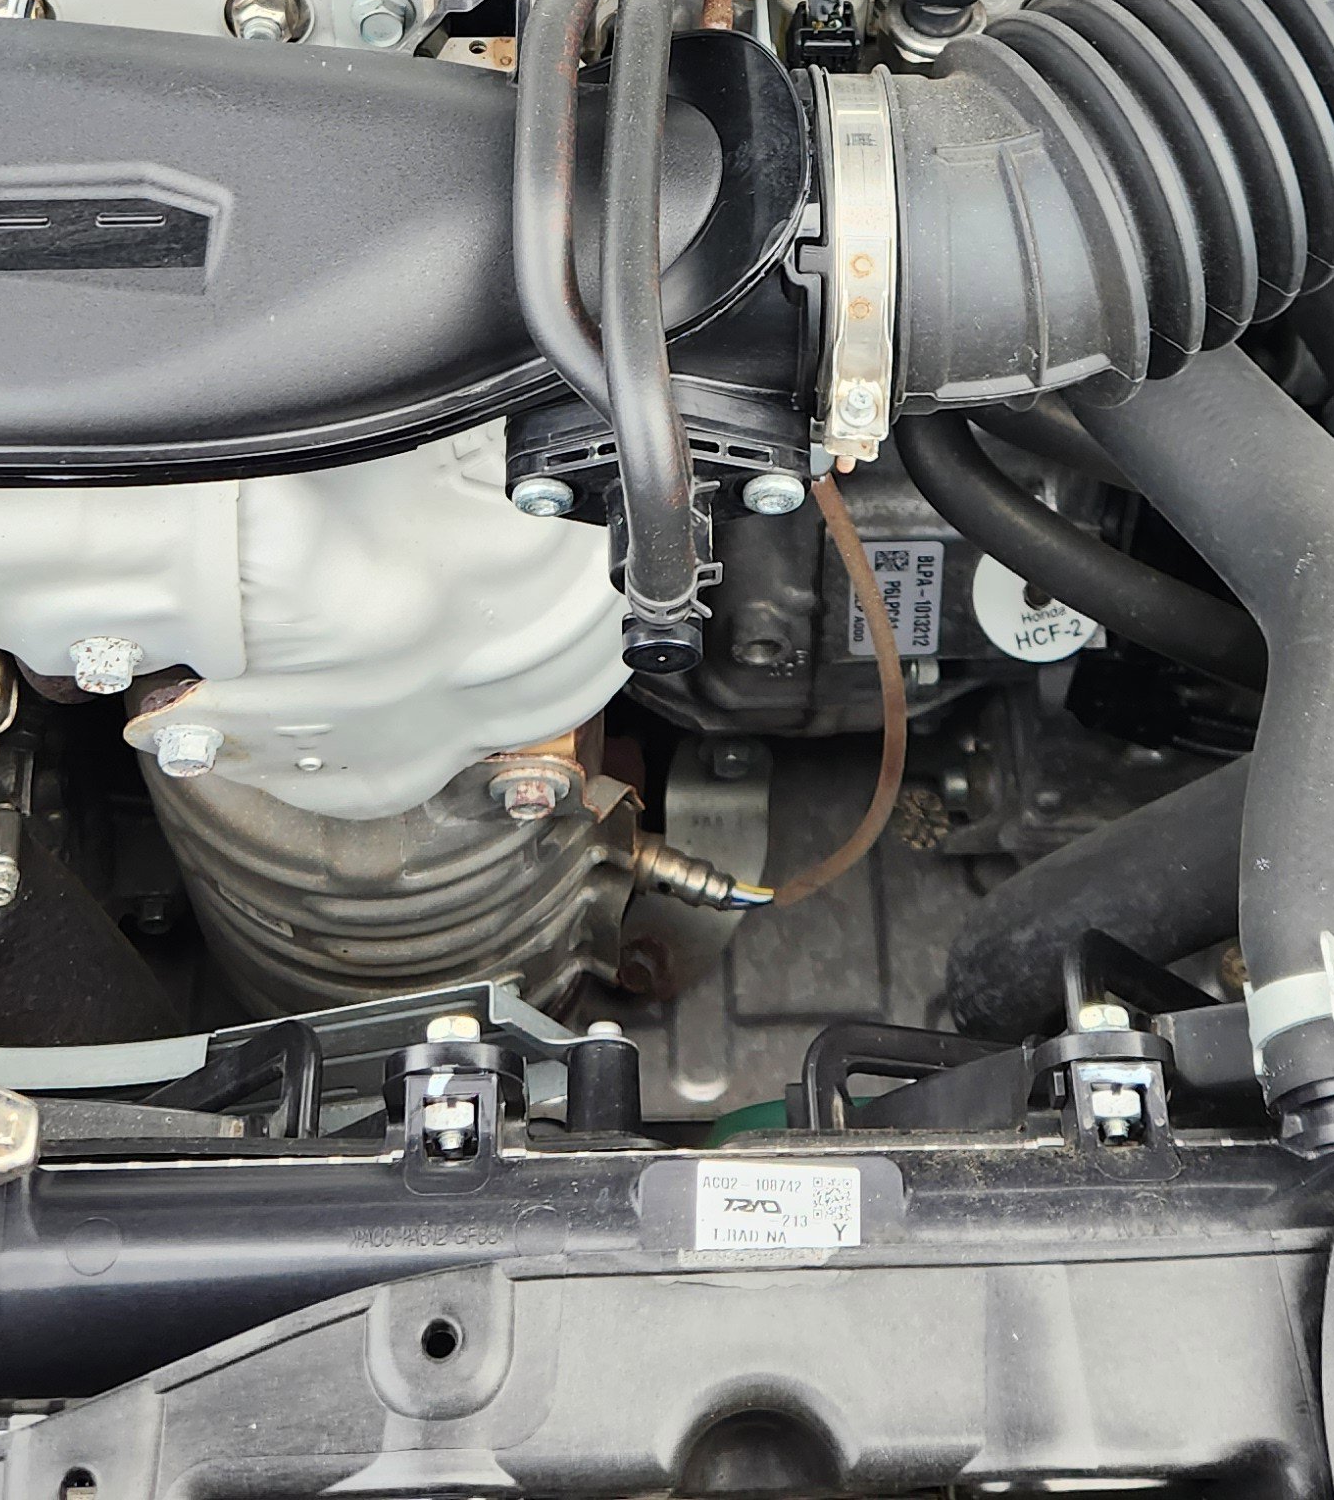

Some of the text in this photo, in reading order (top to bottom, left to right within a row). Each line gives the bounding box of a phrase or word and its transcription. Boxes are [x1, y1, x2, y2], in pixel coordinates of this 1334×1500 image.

[1021, 606, 1067, 624] Honda
[1015, 619, 1083, 650] HCF-2
[766, 1230, 787, 1244] NA
[833, 1223, 847, 1242] Y
